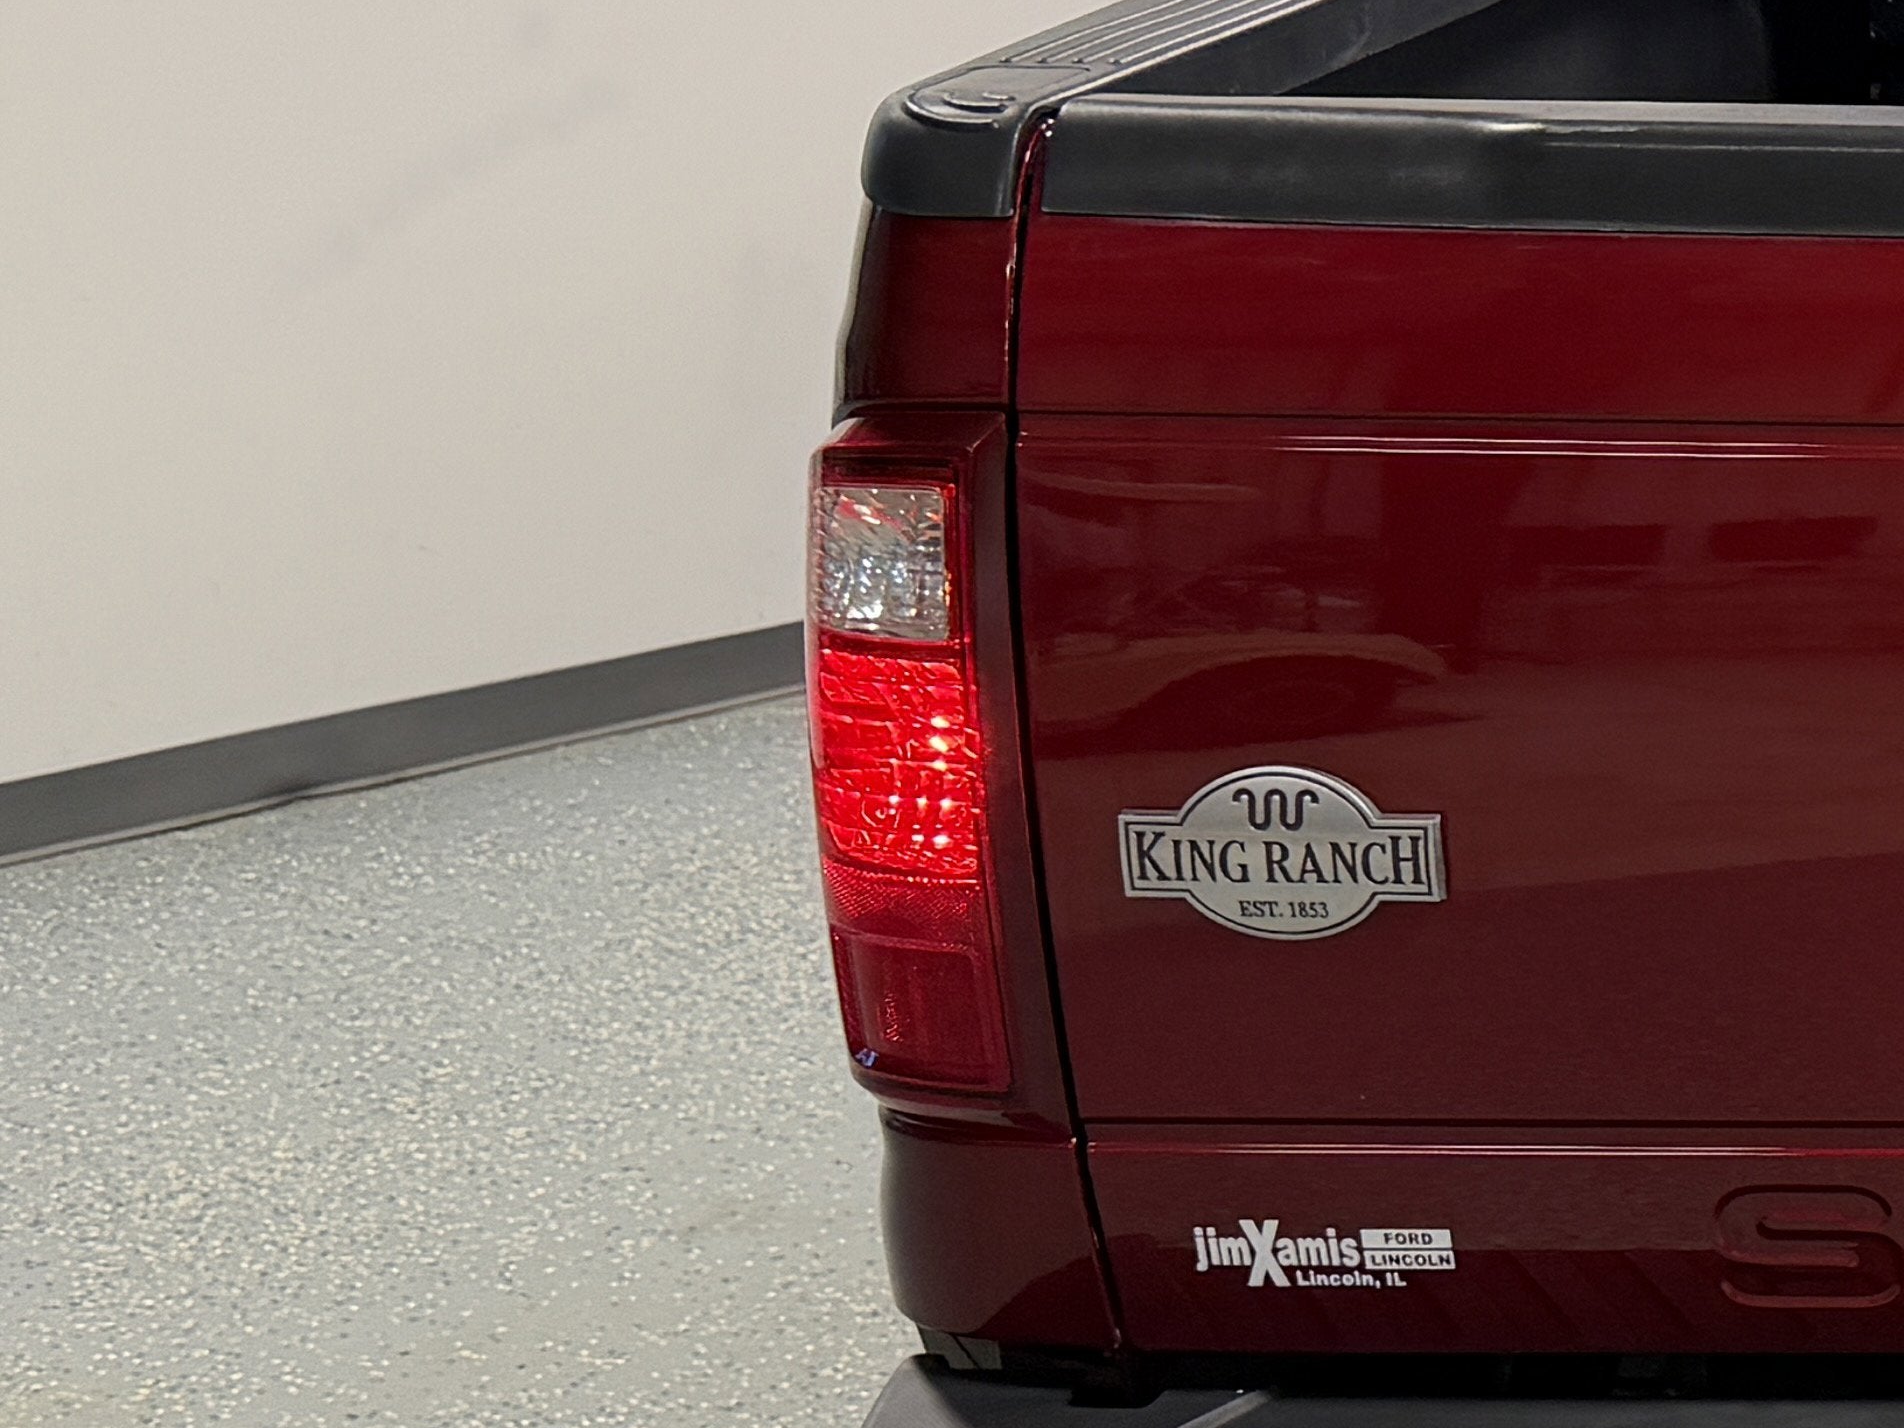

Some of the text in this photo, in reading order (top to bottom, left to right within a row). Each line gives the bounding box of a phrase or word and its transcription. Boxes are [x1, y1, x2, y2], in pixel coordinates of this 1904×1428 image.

[1134, 830, 1426, 886] KING RANCH
[1239, 900, 1330, 919] EST. 1853
[1383, 1232, 1433, 1246] FORD
[1370, 1253, 1452, 1268] LINCOLN
[1295, 1270, 1407, 1289] Lincoln, IL
